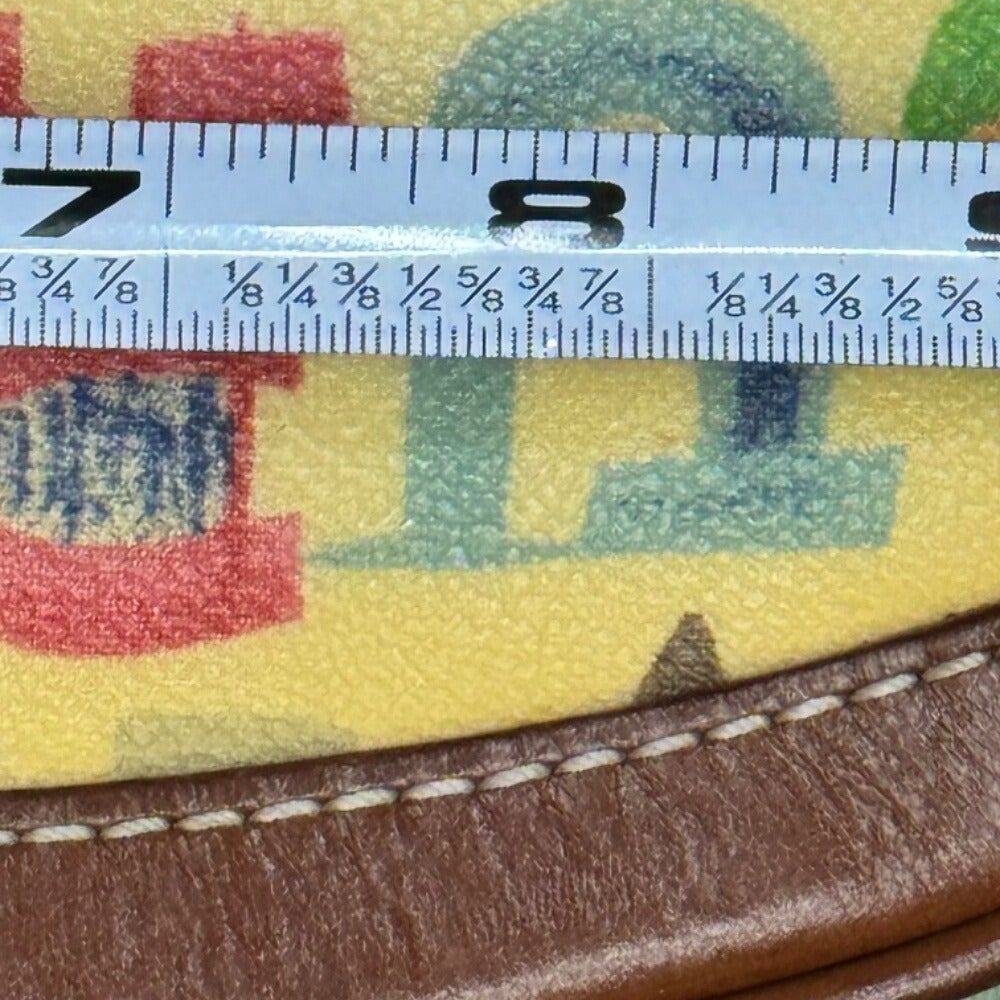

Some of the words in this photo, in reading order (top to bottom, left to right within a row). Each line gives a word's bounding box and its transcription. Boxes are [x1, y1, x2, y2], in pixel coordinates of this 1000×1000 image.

[2, 168, 141, 238] 7
[488, 180, 626, 248] 8
[32, 257, 78, 300] 3/4
[94, 258, 138, 303] 7/8
[223, 260, 264, 306] 1/8
[277, 262, 317, 306] 1/4
[333, 262, 380, 309] 3/8
[400, 264, 442, 311] 1/2
[458, 266, 504, 312] 5/8
[518, 266, 563, 313] 3/4
[579, 268, 624, 314] 7/8
[706, 271, 746, 316] 1/8
[759, 272, 800, 316] 1/4
[815, 272, 861, 318] 3/8
[881, 275, 920, 321] 1/2
[937, 275, 983, 322] 5/8
